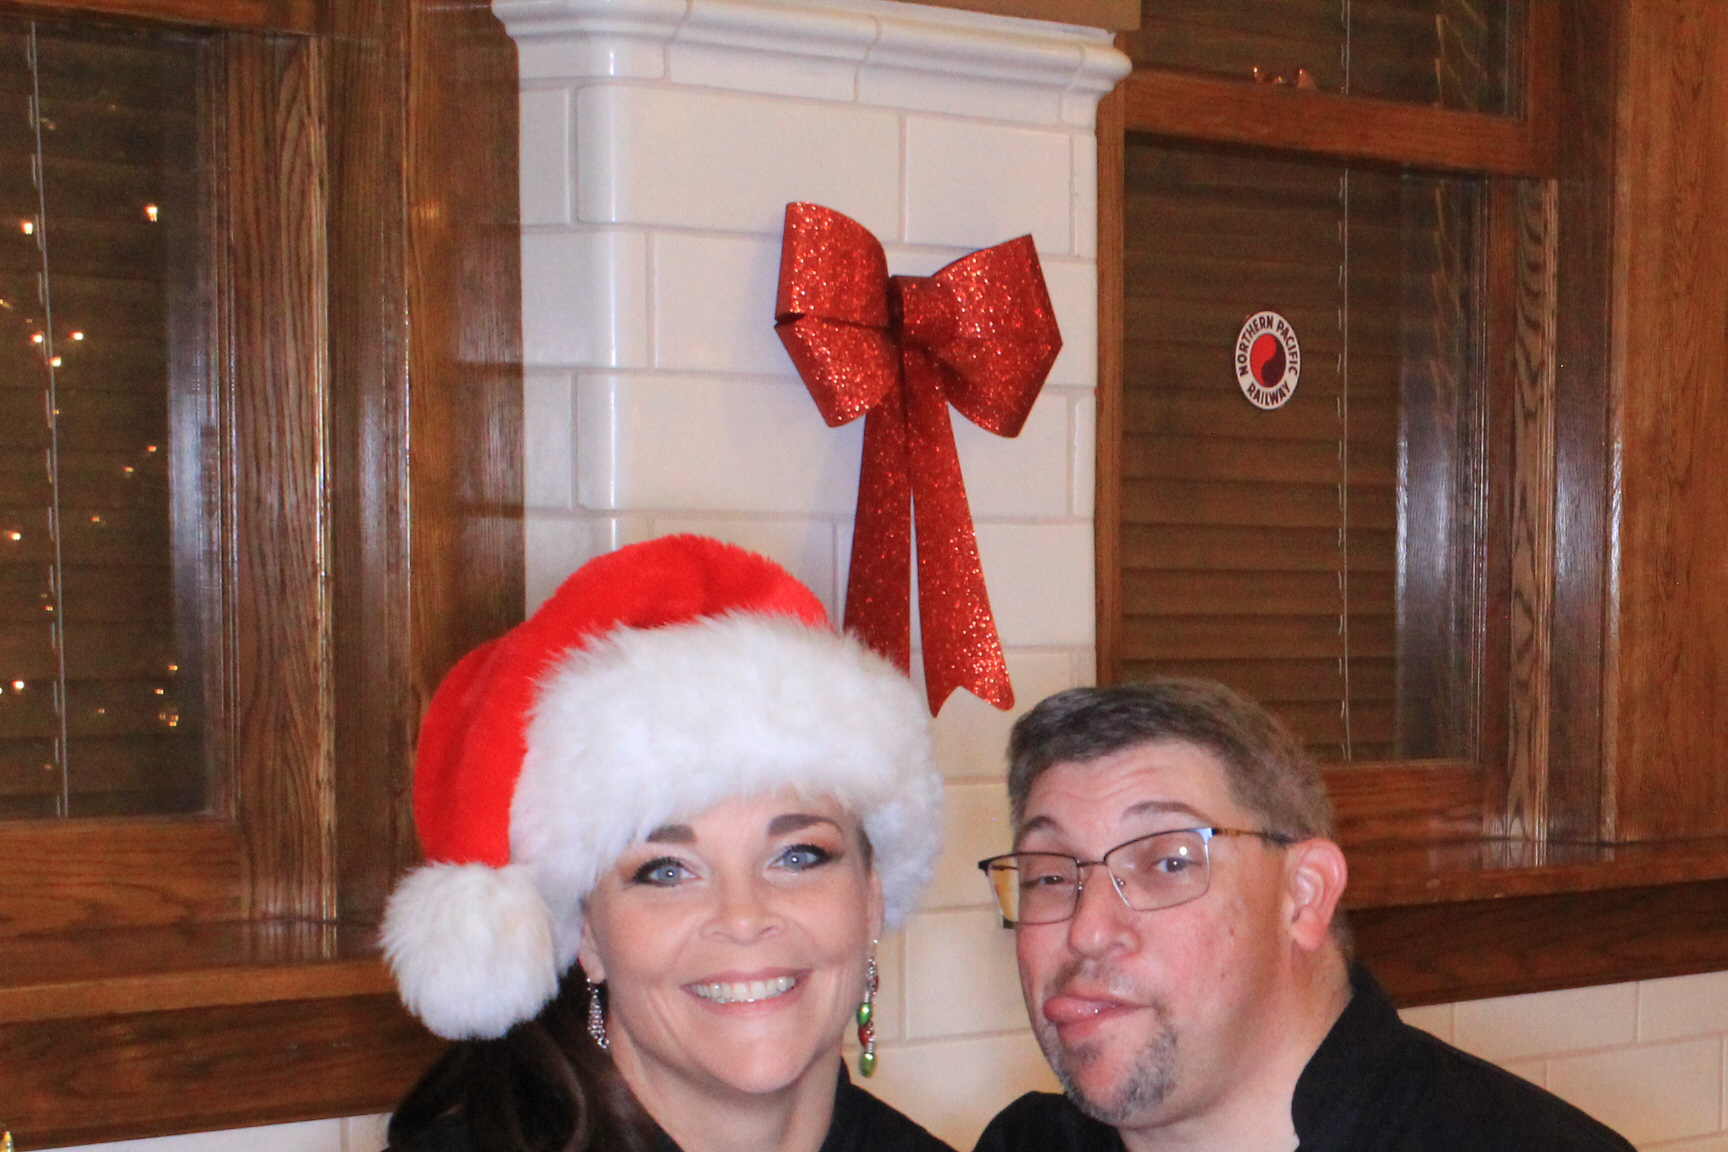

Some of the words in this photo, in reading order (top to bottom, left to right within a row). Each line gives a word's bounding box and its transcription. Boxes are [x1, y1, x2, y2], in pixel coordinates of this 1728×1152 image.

[1237, 315, 1274, 377] NORTHERN
[1276, 319, 1299, 376] PACIFIC
[1247, 381, 1291, 406] RAILWAY
